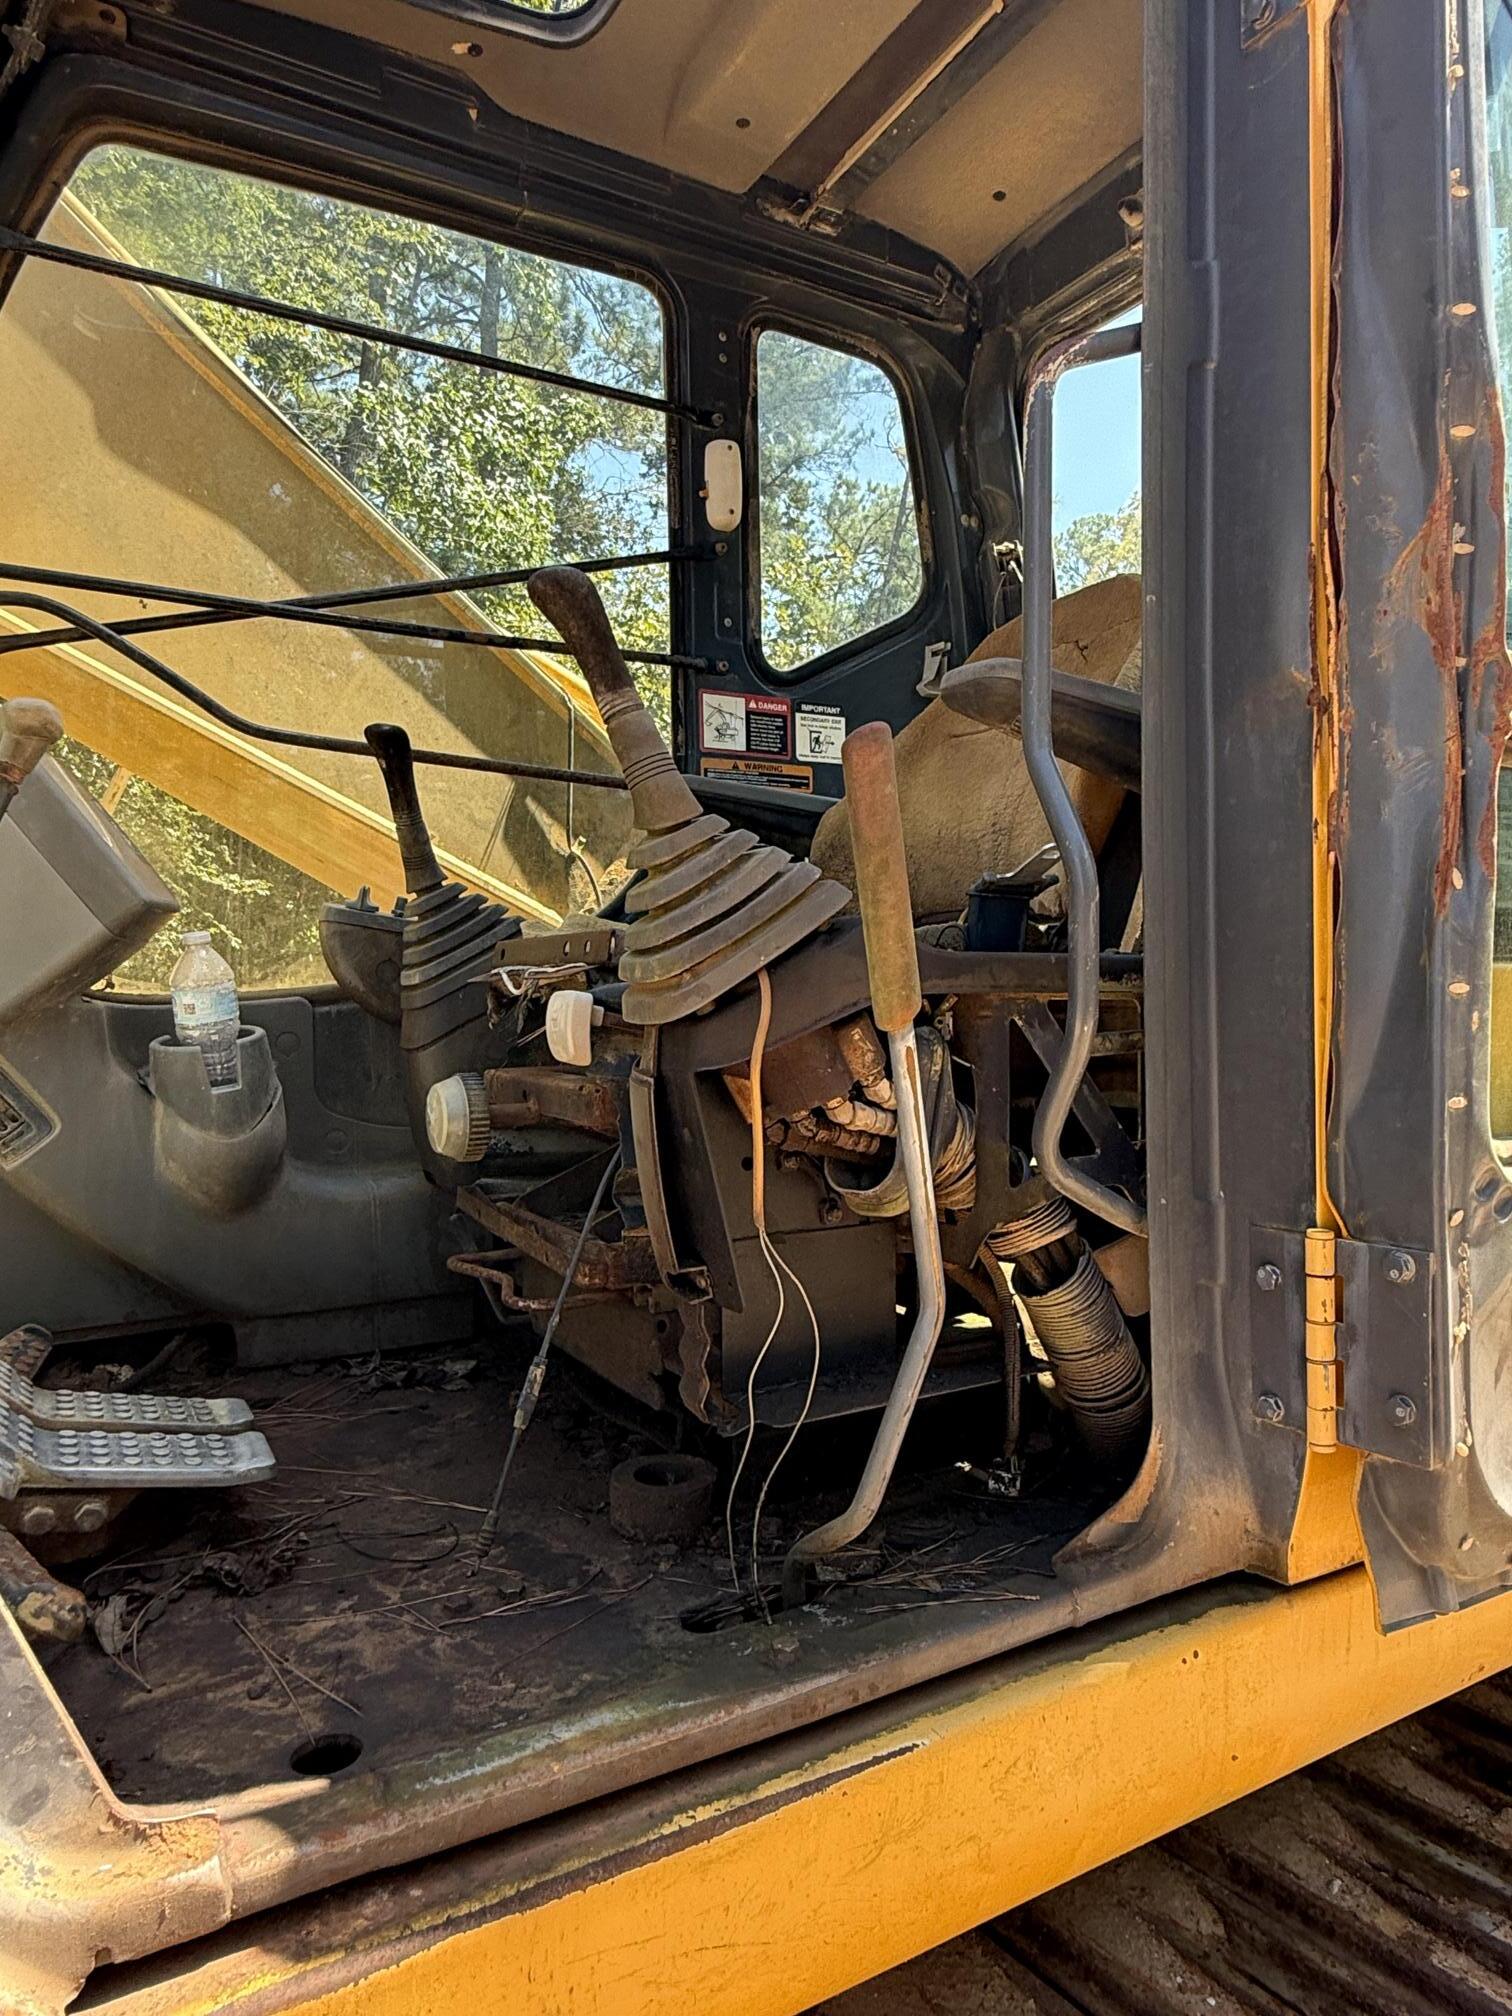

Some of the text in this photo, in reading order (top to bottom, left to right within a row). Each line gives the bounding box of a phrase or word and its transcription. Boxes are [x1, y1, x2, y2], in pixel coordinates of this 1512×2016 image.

[758, 701, 788, 712] DANGER
[800, 703, 841, 714] IMPORTANT
[800, 715, 830, 723] SECONDARY
[744, 762, 783, 773] WARNING
